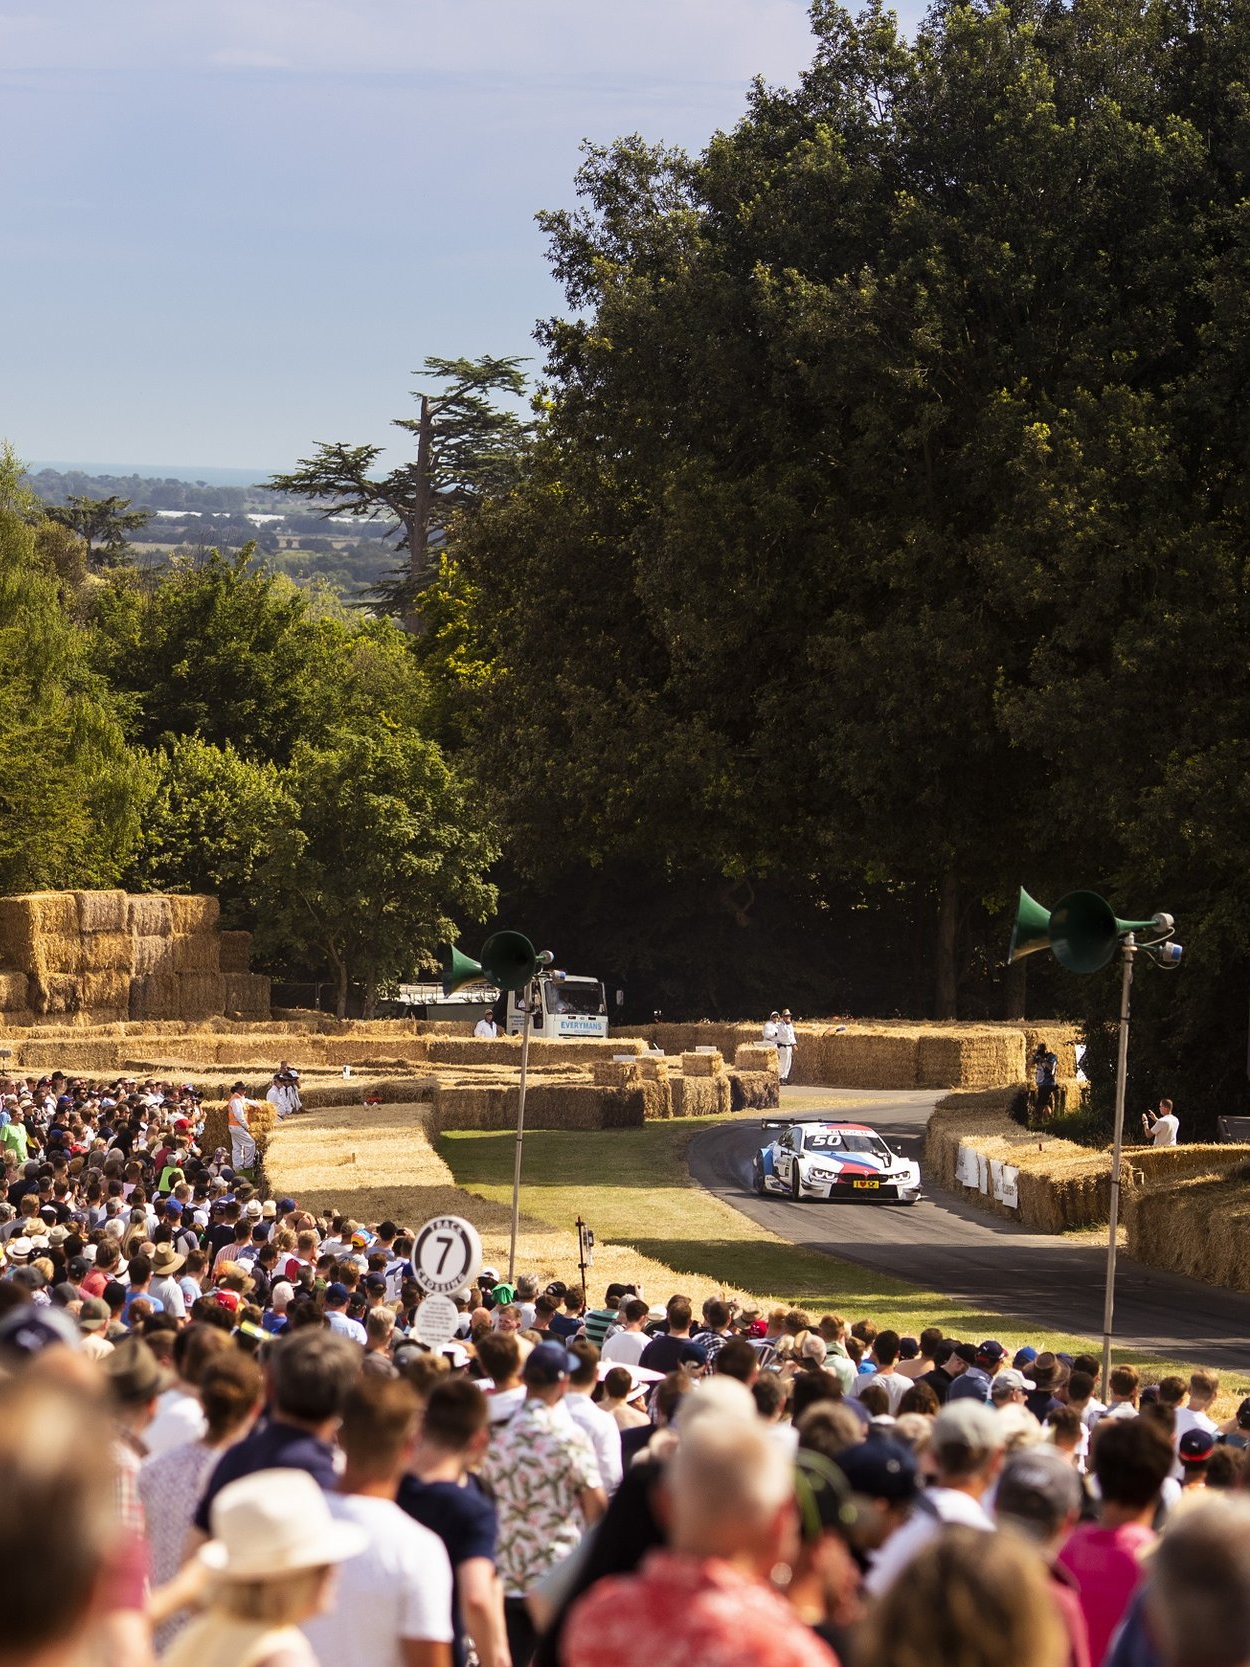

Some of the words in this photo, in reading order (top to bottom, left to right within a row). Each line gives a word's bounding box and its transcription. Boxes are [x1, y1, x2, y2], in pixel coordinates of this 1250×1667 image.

[561, 1021, 602, 1030] EVERYMANS
[812, 1135, 842, 1146] 50
[430, 1220, 463, 1234] TRACK
[436, 1237, 454, 1275] 7
